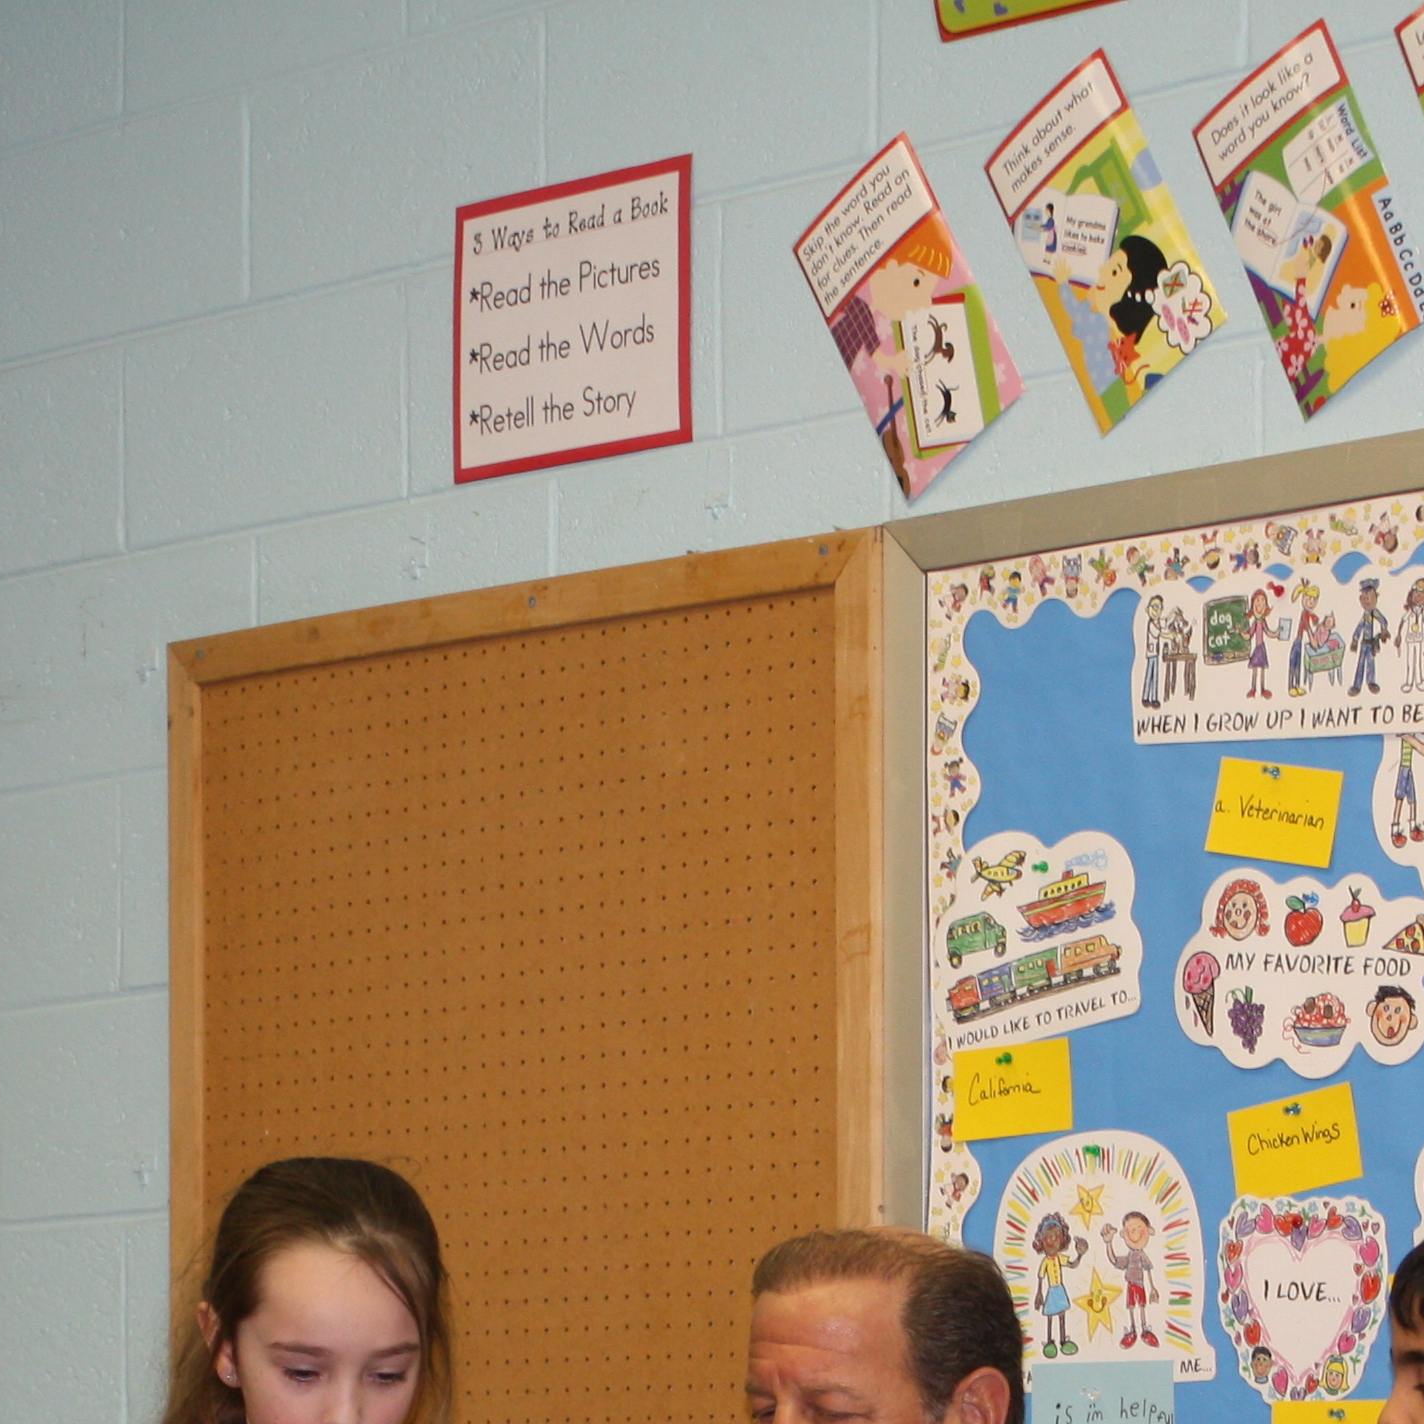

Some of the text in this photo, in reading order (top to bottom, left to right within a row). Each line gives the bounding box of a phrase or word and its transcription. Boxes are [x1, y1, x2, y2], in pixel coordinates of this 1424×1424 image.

[1211, 53, 1314, 145] Does it look like a
[1218, 73, 1310, 160] word you know?
[1003, 82, 1094, 175] Think about what
[1337, 103, 1368, 159] Word List
[1012, 125, 1076, 193] makes sense.
[492, 191, 668, 251] Ways to Read a Book
[803, 165, 890, 261] Skip the word you
[834, 169, 909, 249] know. Read on
[818, 186, 912, 290] for clues. Then read
[540, 259, 660, 300] the Pictures
[825, 239, 884, 305] the sentence.
[538, 313, 654, 362] the Words
[542, 386, 636, 423] the Story
[1208, 632, 1230, 646] cat
[1211, 611, 1232, 626] dog
[1137, 706, 1395, 736] WHEN I GROW UP I WANT TO
[1240, 794, 1324, 829] Veterinarian
[1226, 953, 1411, 976] MY FAVORITE FOOD
[956, 996, 1106, 1049] WOULD LIKE TO TRAVEL
[969, 1073, 1041, 1106] California
[1248, 1121, 1341, 1155] Chicken Wings
[1264, 1279, 1269, 1300] I
